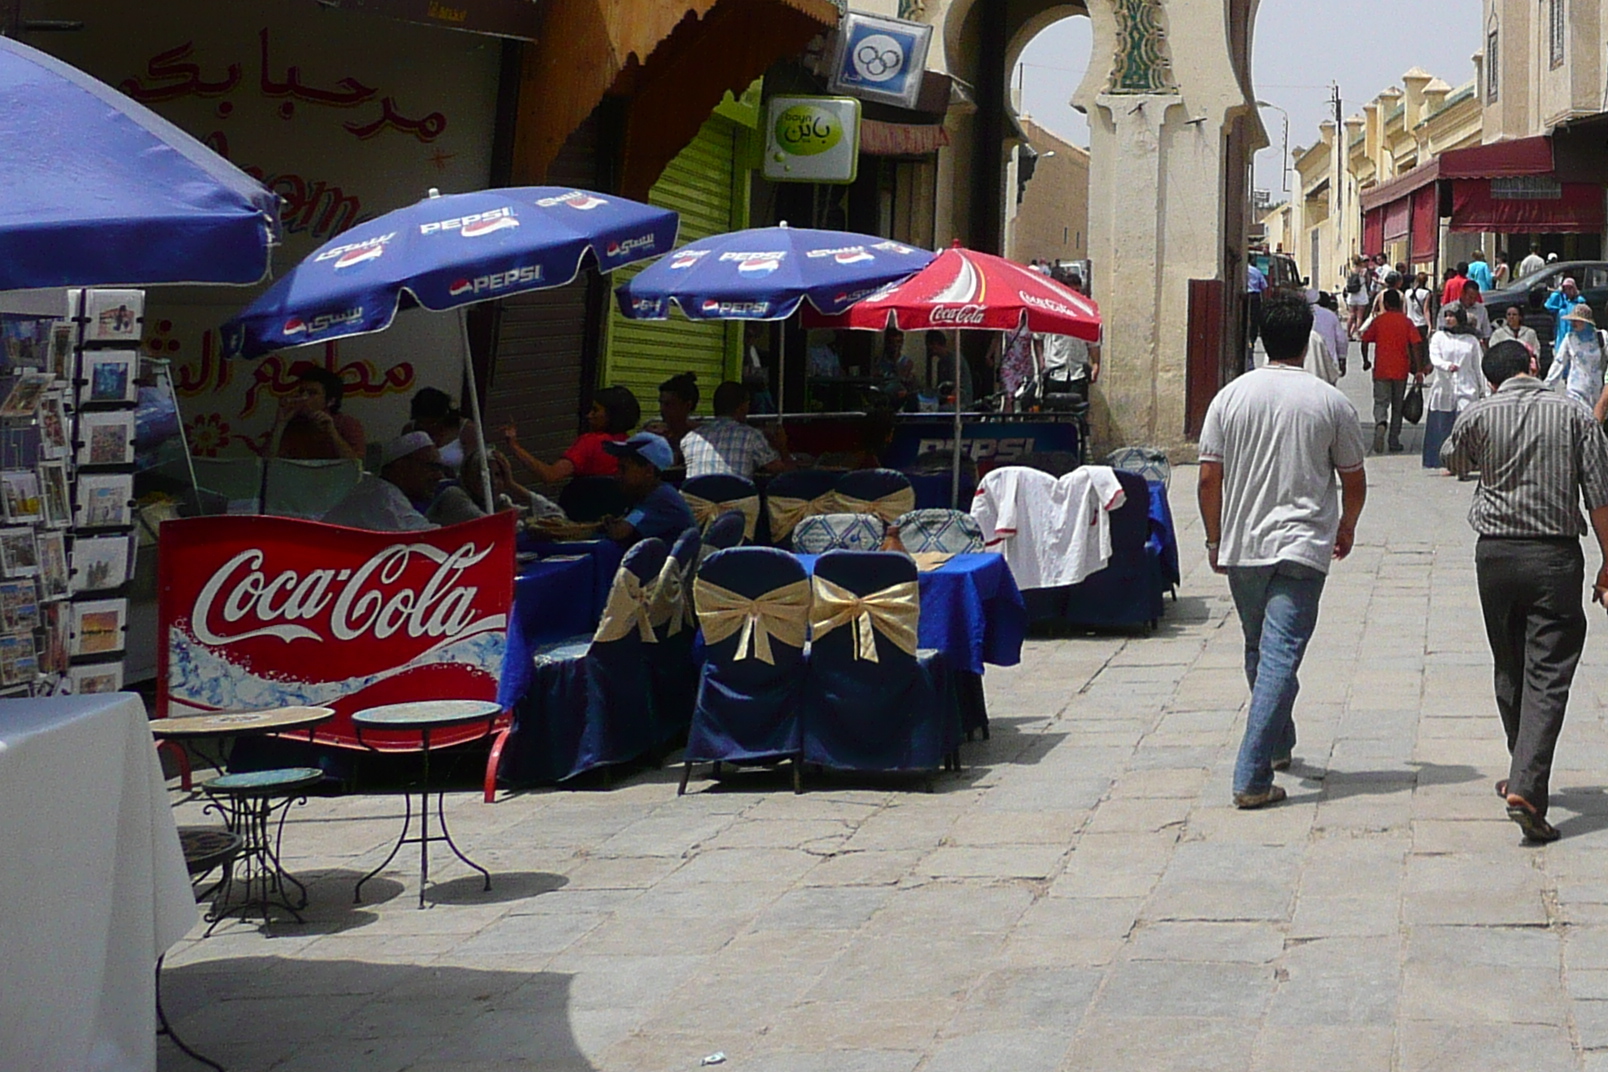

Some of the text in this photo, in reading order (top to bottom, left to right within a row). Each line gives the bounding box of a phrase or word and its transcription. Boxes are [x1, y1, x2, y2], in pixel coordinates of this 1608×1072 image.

[259, 26, 447, 143] مرحبا
[420, 206, 512, 234] PEPSI
[718, 251, 788, 261] PEPSI
[472, 264, 542, 294] PEPSI
[719, 301, 770, 314] PEPSI
[929, 304, 989, 325] Coca-Cola
[191, 541, 495, 646] Coca-Cola
